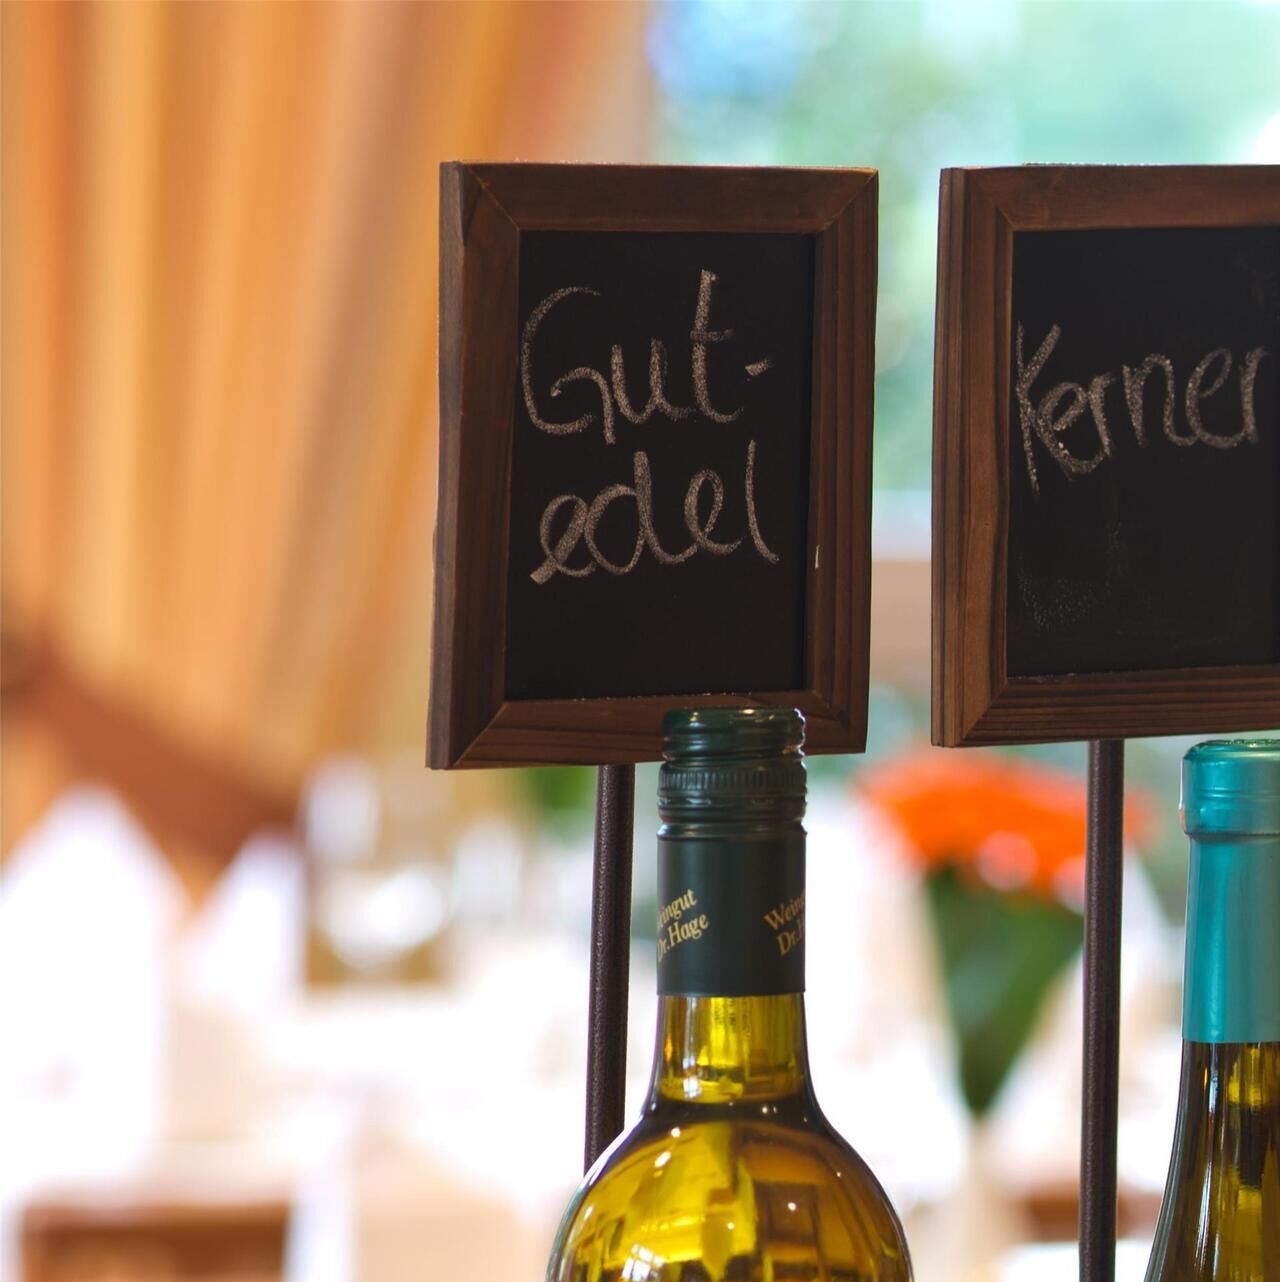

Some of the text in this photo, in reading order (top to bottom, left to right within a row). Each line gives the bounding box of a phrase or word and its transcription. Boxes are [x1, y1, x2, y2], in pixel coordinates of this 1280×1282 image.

[521, 269, 773, 445] Gut-
[1016, 320, 1270, 498] Kerner
[530, 439, 780, 585] edel
